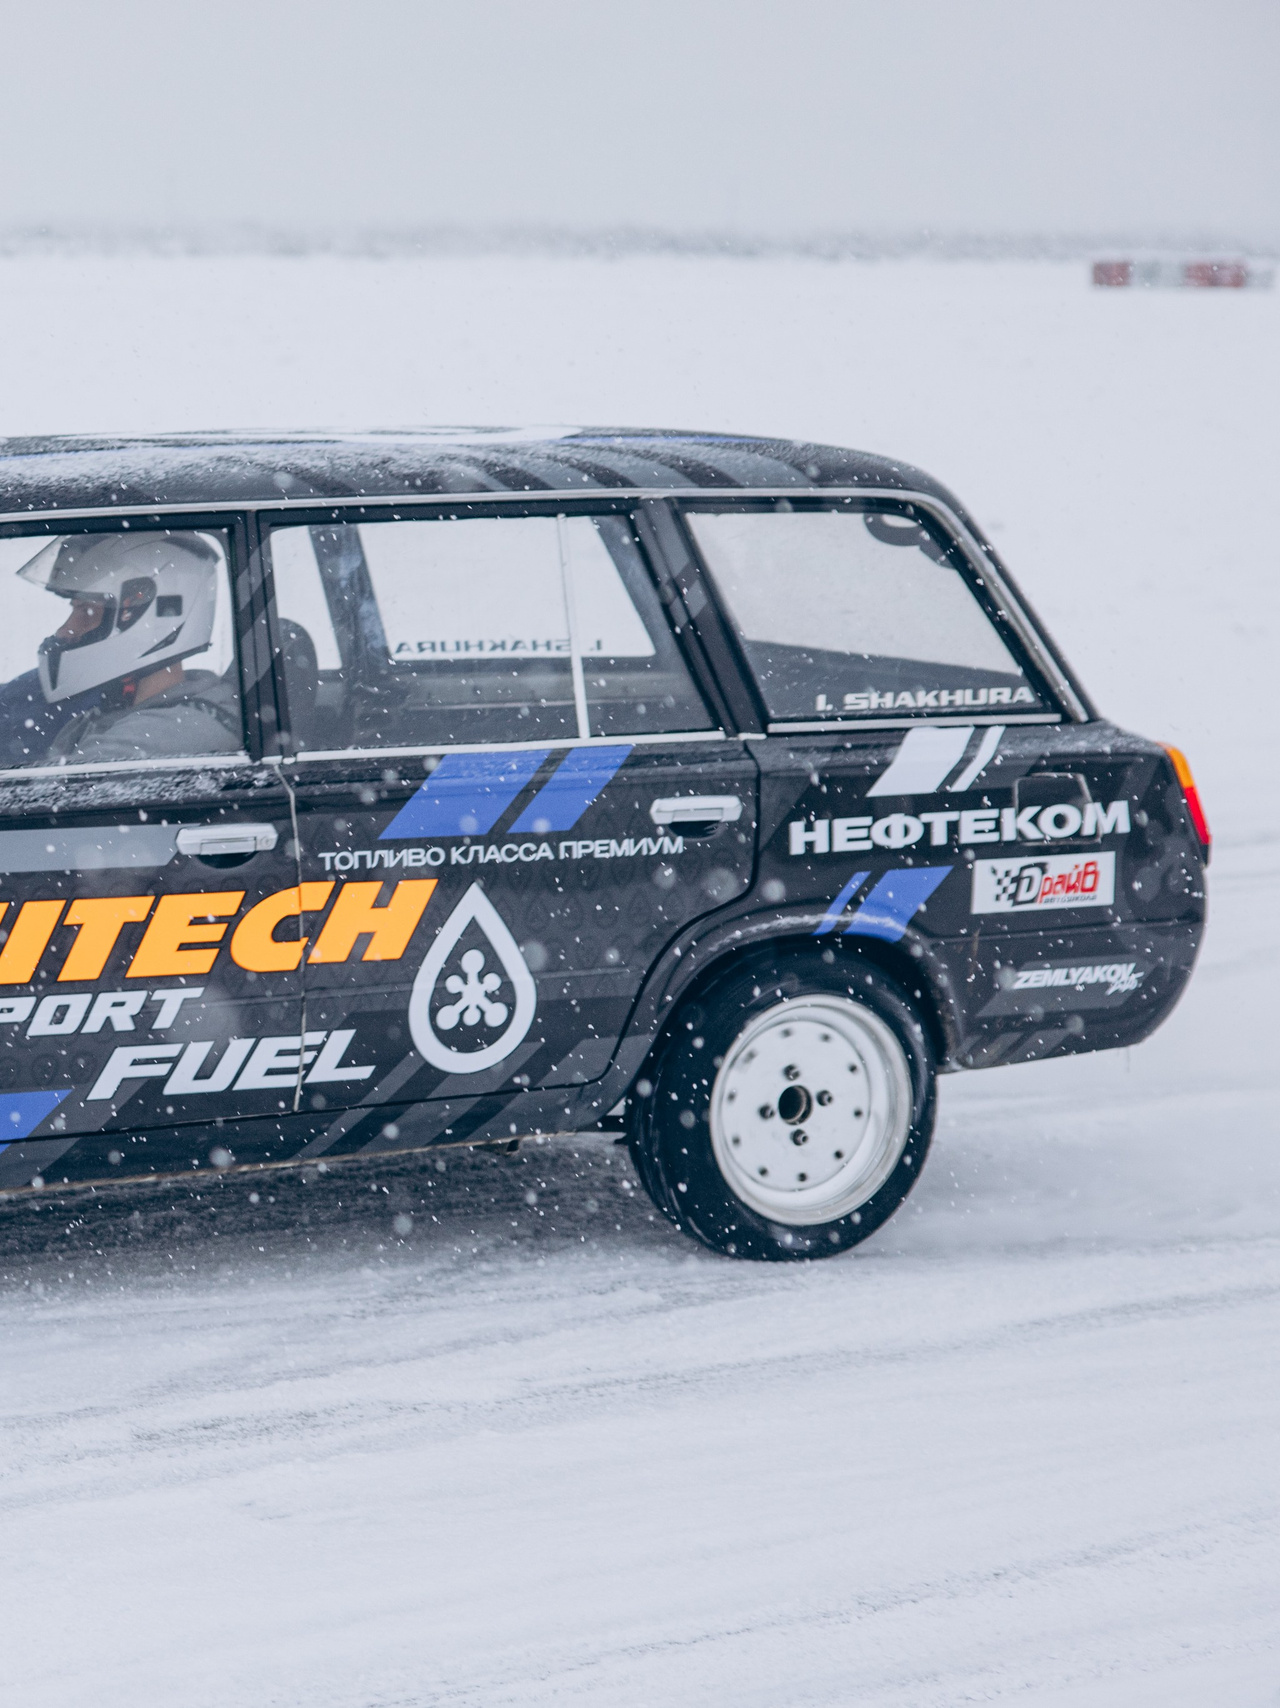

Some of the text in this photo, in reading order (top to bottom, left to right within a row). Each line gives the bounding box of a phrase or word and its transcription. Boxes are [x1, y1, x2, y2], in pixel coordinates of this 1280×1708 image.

[815, 686, 1037, 712] I. SHAKHURA
[789, 800, 1131, 856] НЕФТЕКОМ
[318, 835, 684, 872] ТОПЛИВО КЛАССА ПРЕМИУМ
[1013, 962, 1137, 991] ZEMLYAKOV
[86, 1029, 376, 1101] FUEL
